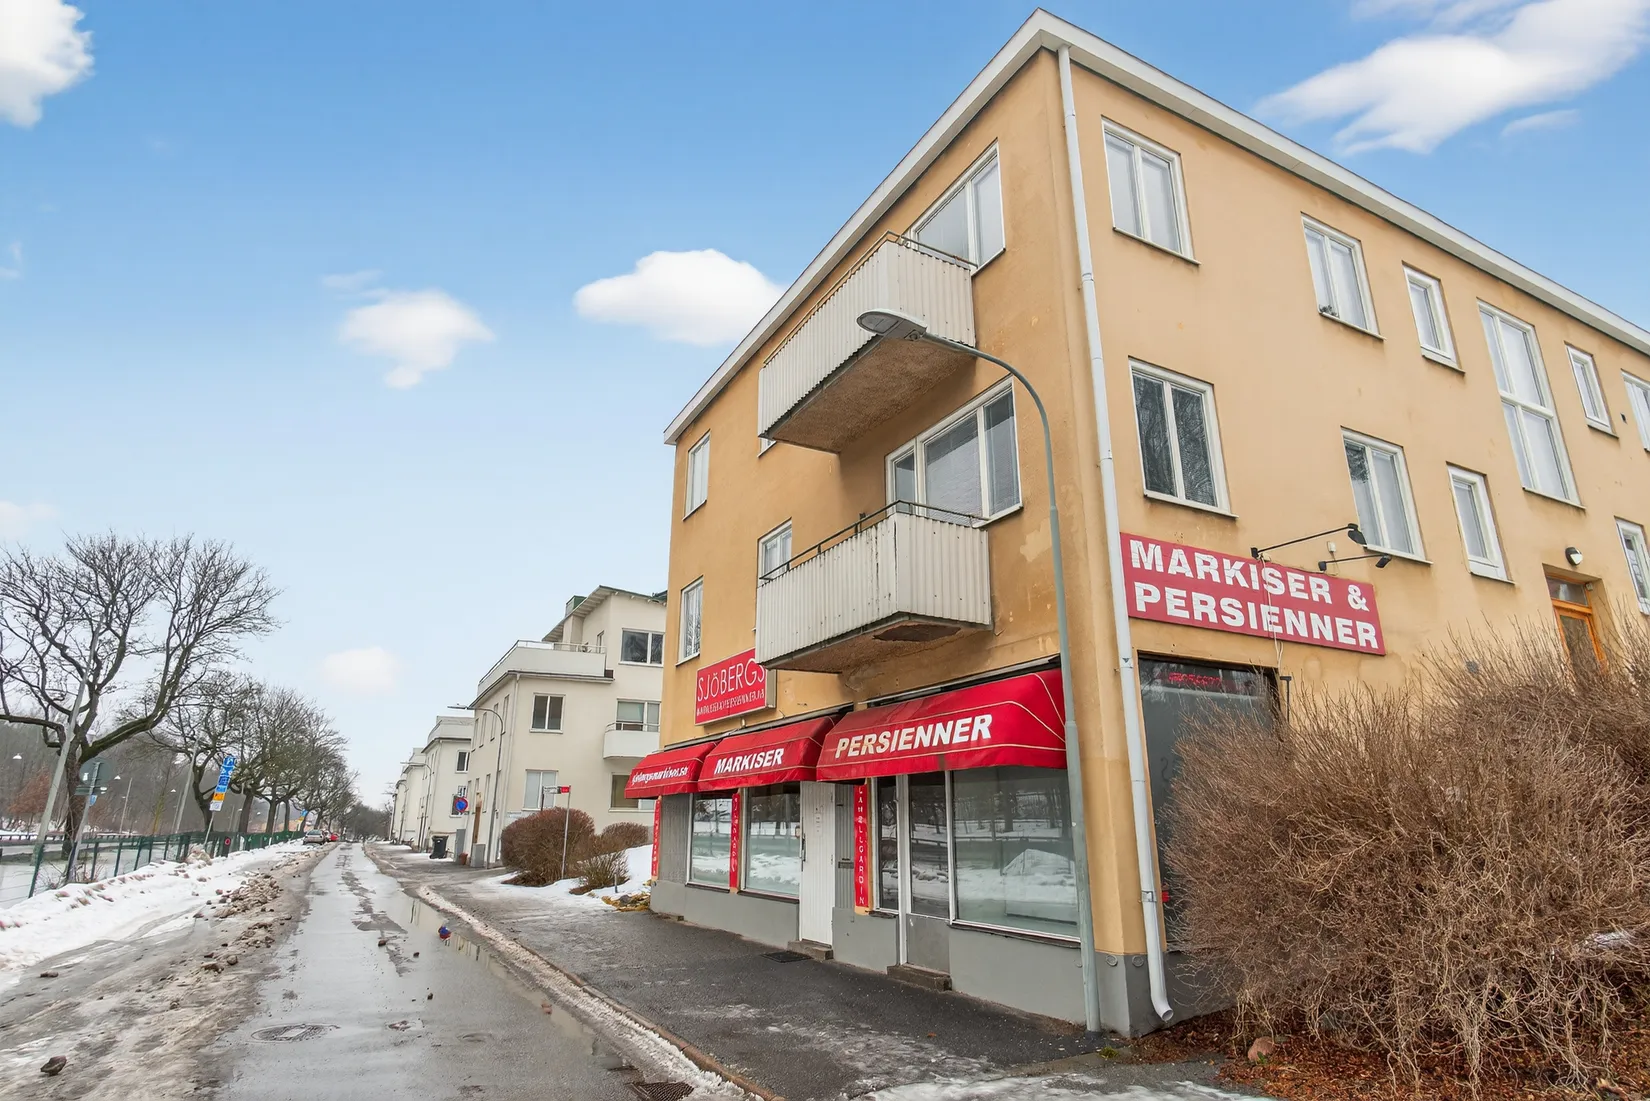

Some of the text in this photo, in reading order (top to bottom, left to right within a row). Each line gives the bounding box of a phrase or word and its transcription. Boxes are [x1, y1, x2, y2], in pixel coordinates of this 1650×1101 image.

[1129, 539, 1370, 612] MARKISER &
[1134, 581, 1379, 649] PERSIENNER
[697, 658, 765, 702] SJÖBERGS
[835, 714, 993, 759] PERSIENNER
[714, 748, 785, 775] MARKISER
